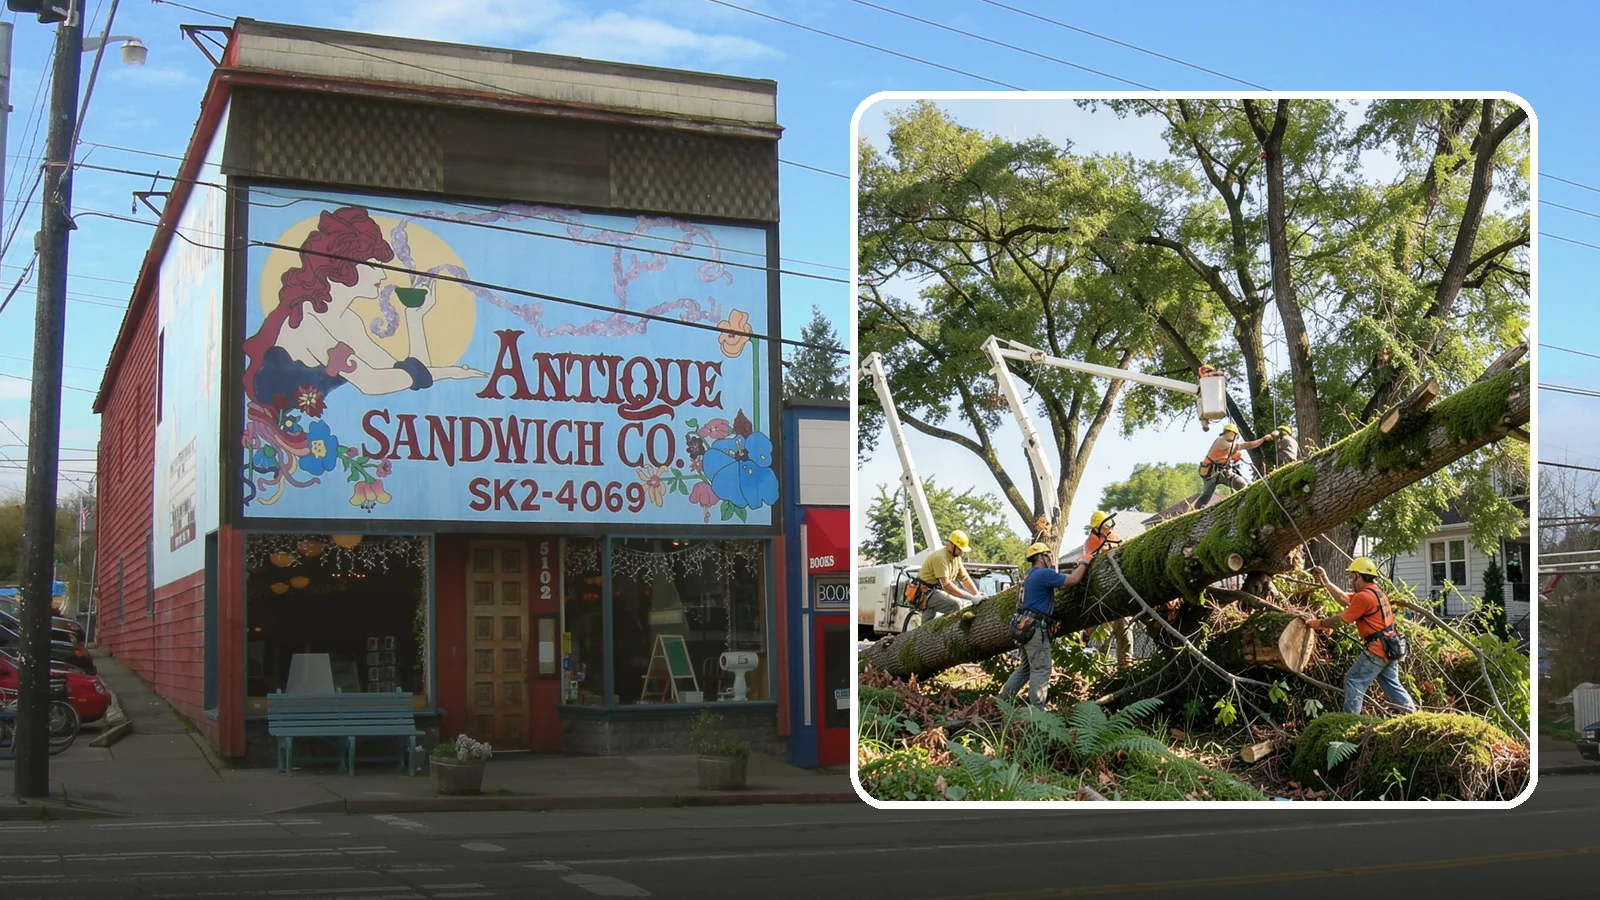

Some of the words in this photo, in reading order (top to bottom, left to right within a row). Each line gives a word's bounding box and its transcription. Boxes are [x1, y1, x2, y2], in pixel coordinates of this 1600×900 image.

[476, 329, 724, 420] ANTIQUE
[361, 409, 605, 467] SANDWICH
[617, 422, 685, 468] CO.
[468, 477, 646, 512] SK2-4069
[540, 541, 552, 600] 5102
[809, 555, 835, 569] BOOKS
